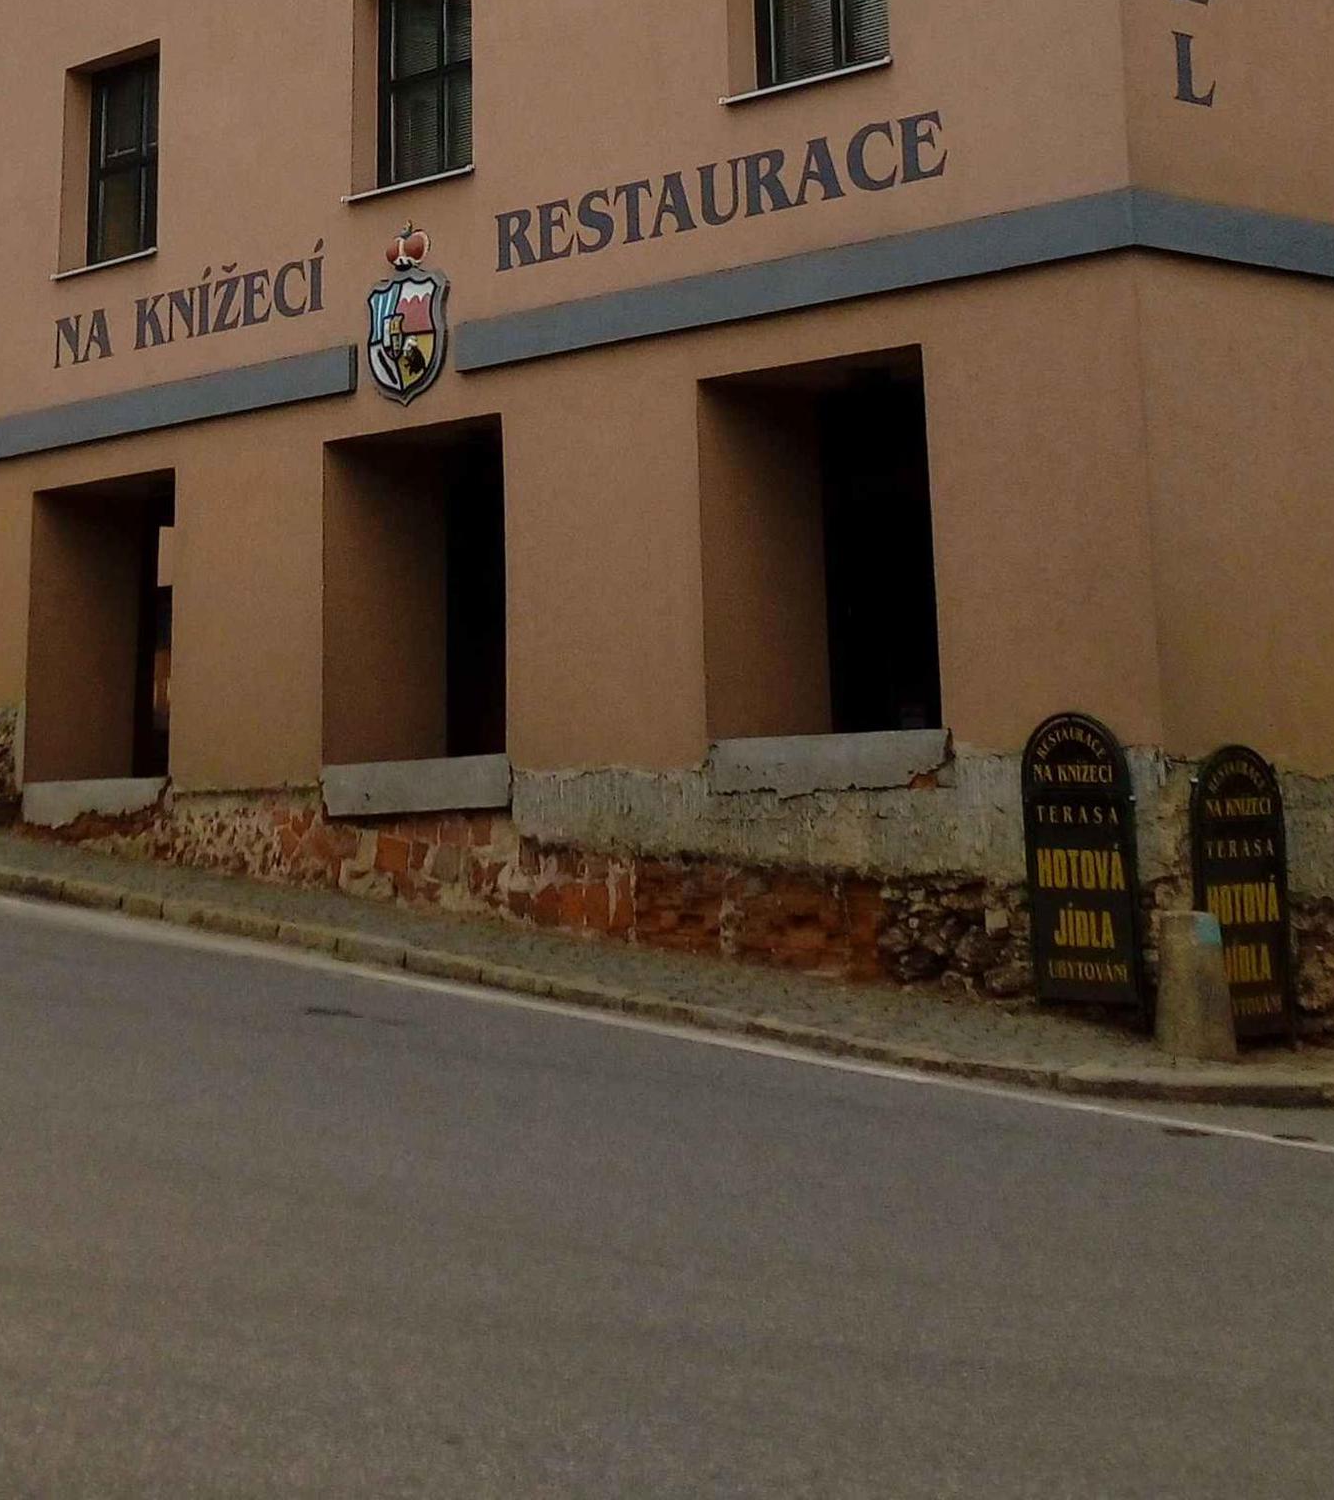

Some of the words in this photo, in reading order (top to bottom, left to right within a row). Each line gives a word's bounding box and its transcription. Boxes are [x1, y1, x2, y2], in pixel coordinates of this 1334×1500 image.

[495, 110, 948, 273] RESTAURACE
[53, 308, 114, 369] NA
[134, 237, 325, 350] KNÍŽECÍ
[1036, 804, 1120, 825] TERASA
[1037, 843, 1126, 891] HOTOVÁ
[1205, 838, 1275, 858] TERASA
[1053, 901, 1116, 949] JÍDLA
